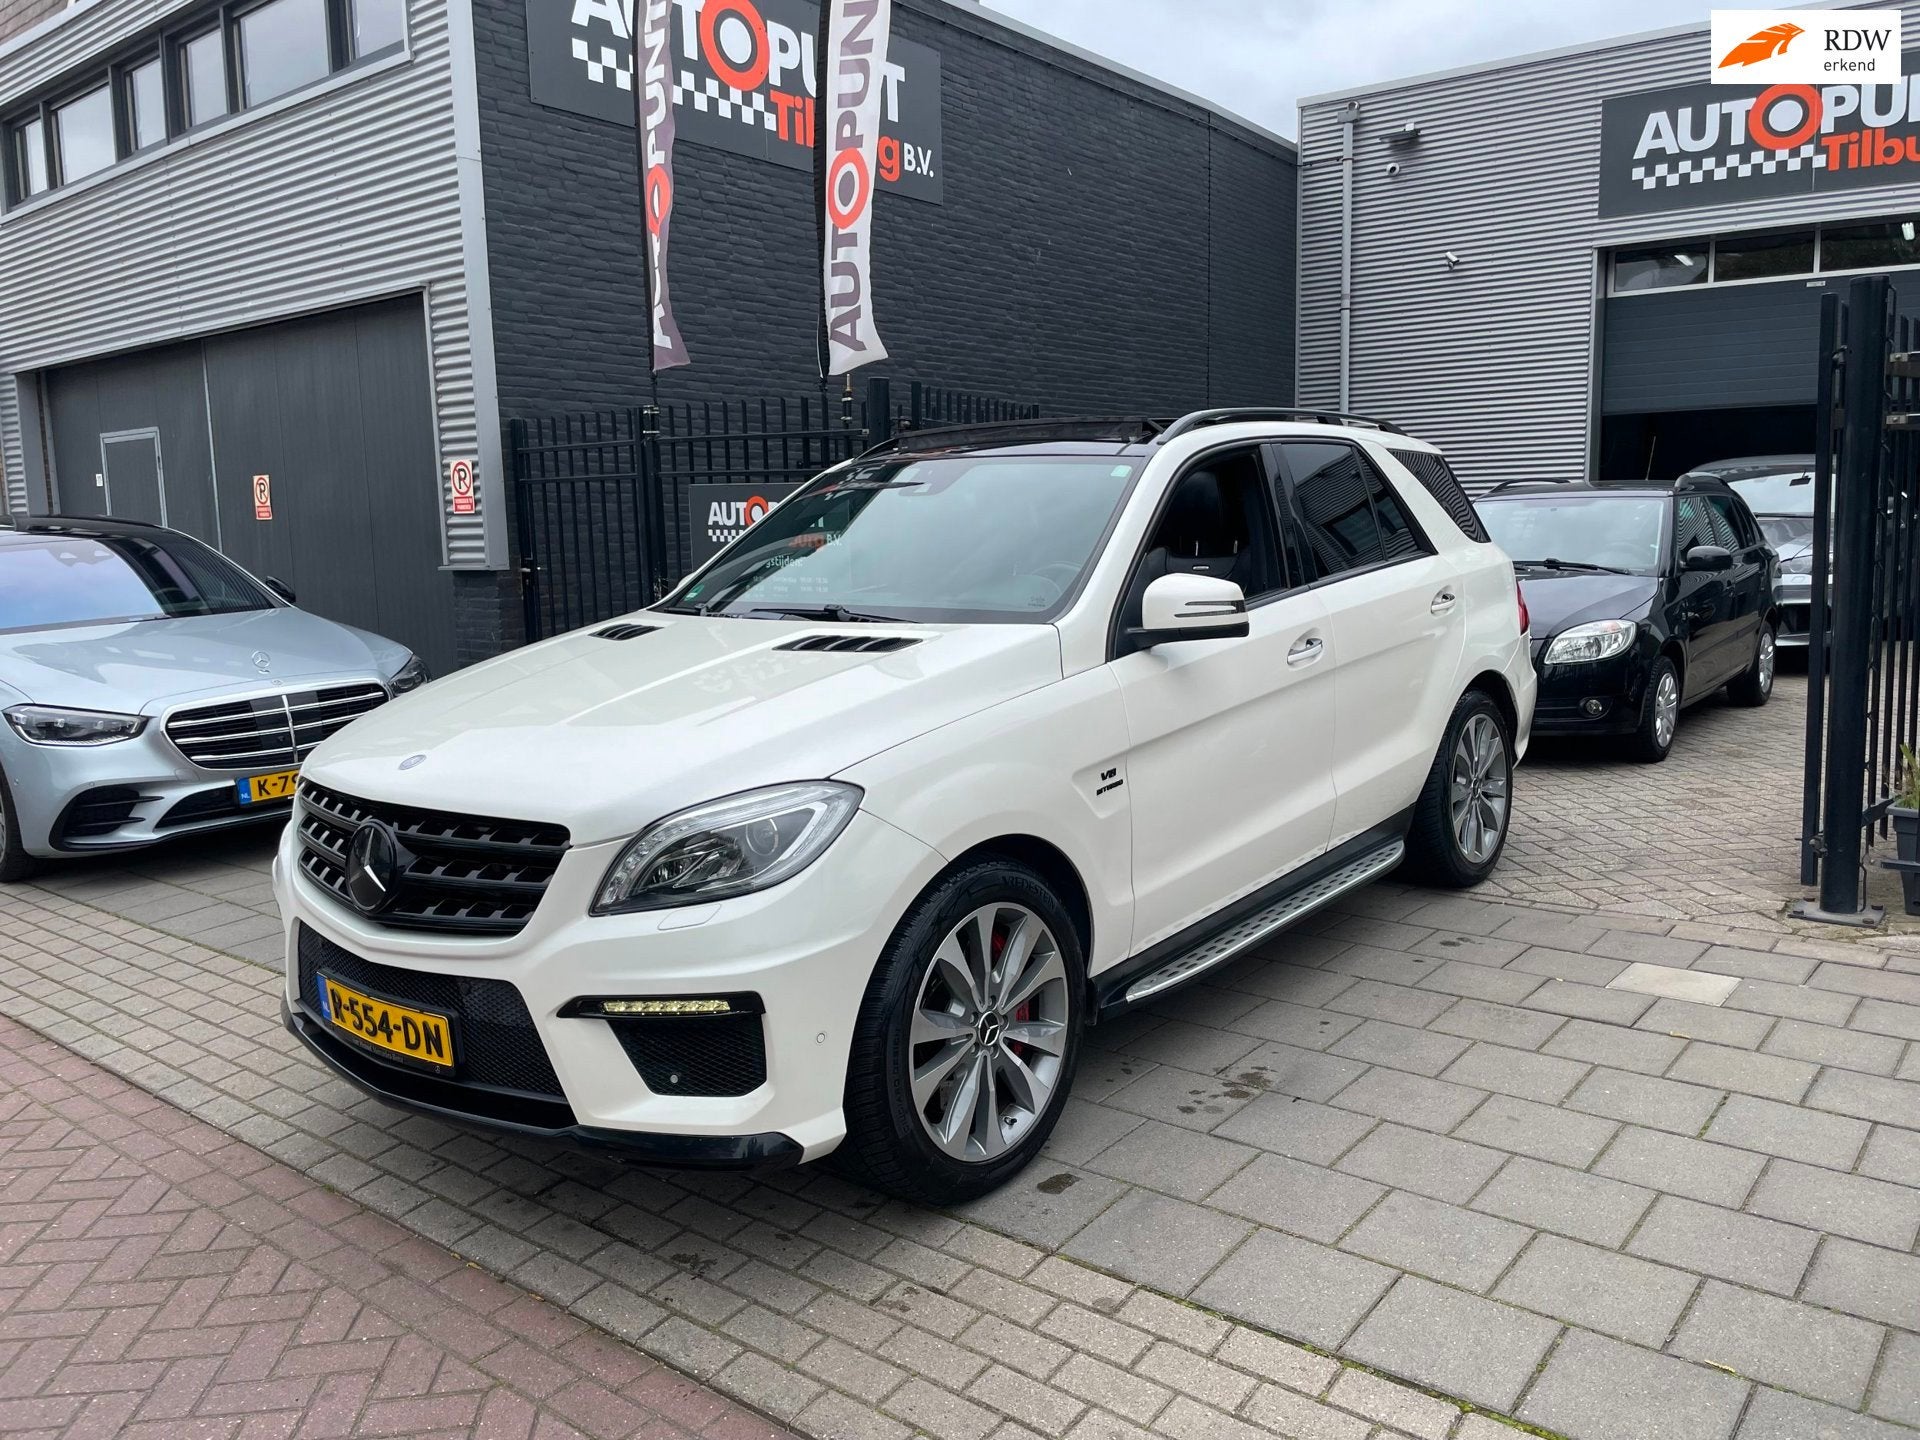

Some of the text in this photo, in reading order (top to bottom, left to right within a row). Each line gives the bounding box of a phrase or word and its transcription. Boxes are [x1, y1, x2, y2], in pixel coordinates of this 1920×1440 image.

[770, 89, 934, 182] Tilg B.V.
[1820, 127, 1920, 172] Tilbu
[828, 0, 880, 352] AUTOPUN
[240, 792, 251, 800] NL
[1101, 767, 1117, 781] V8
[330, 988, 444, 1059] R-554-DN
